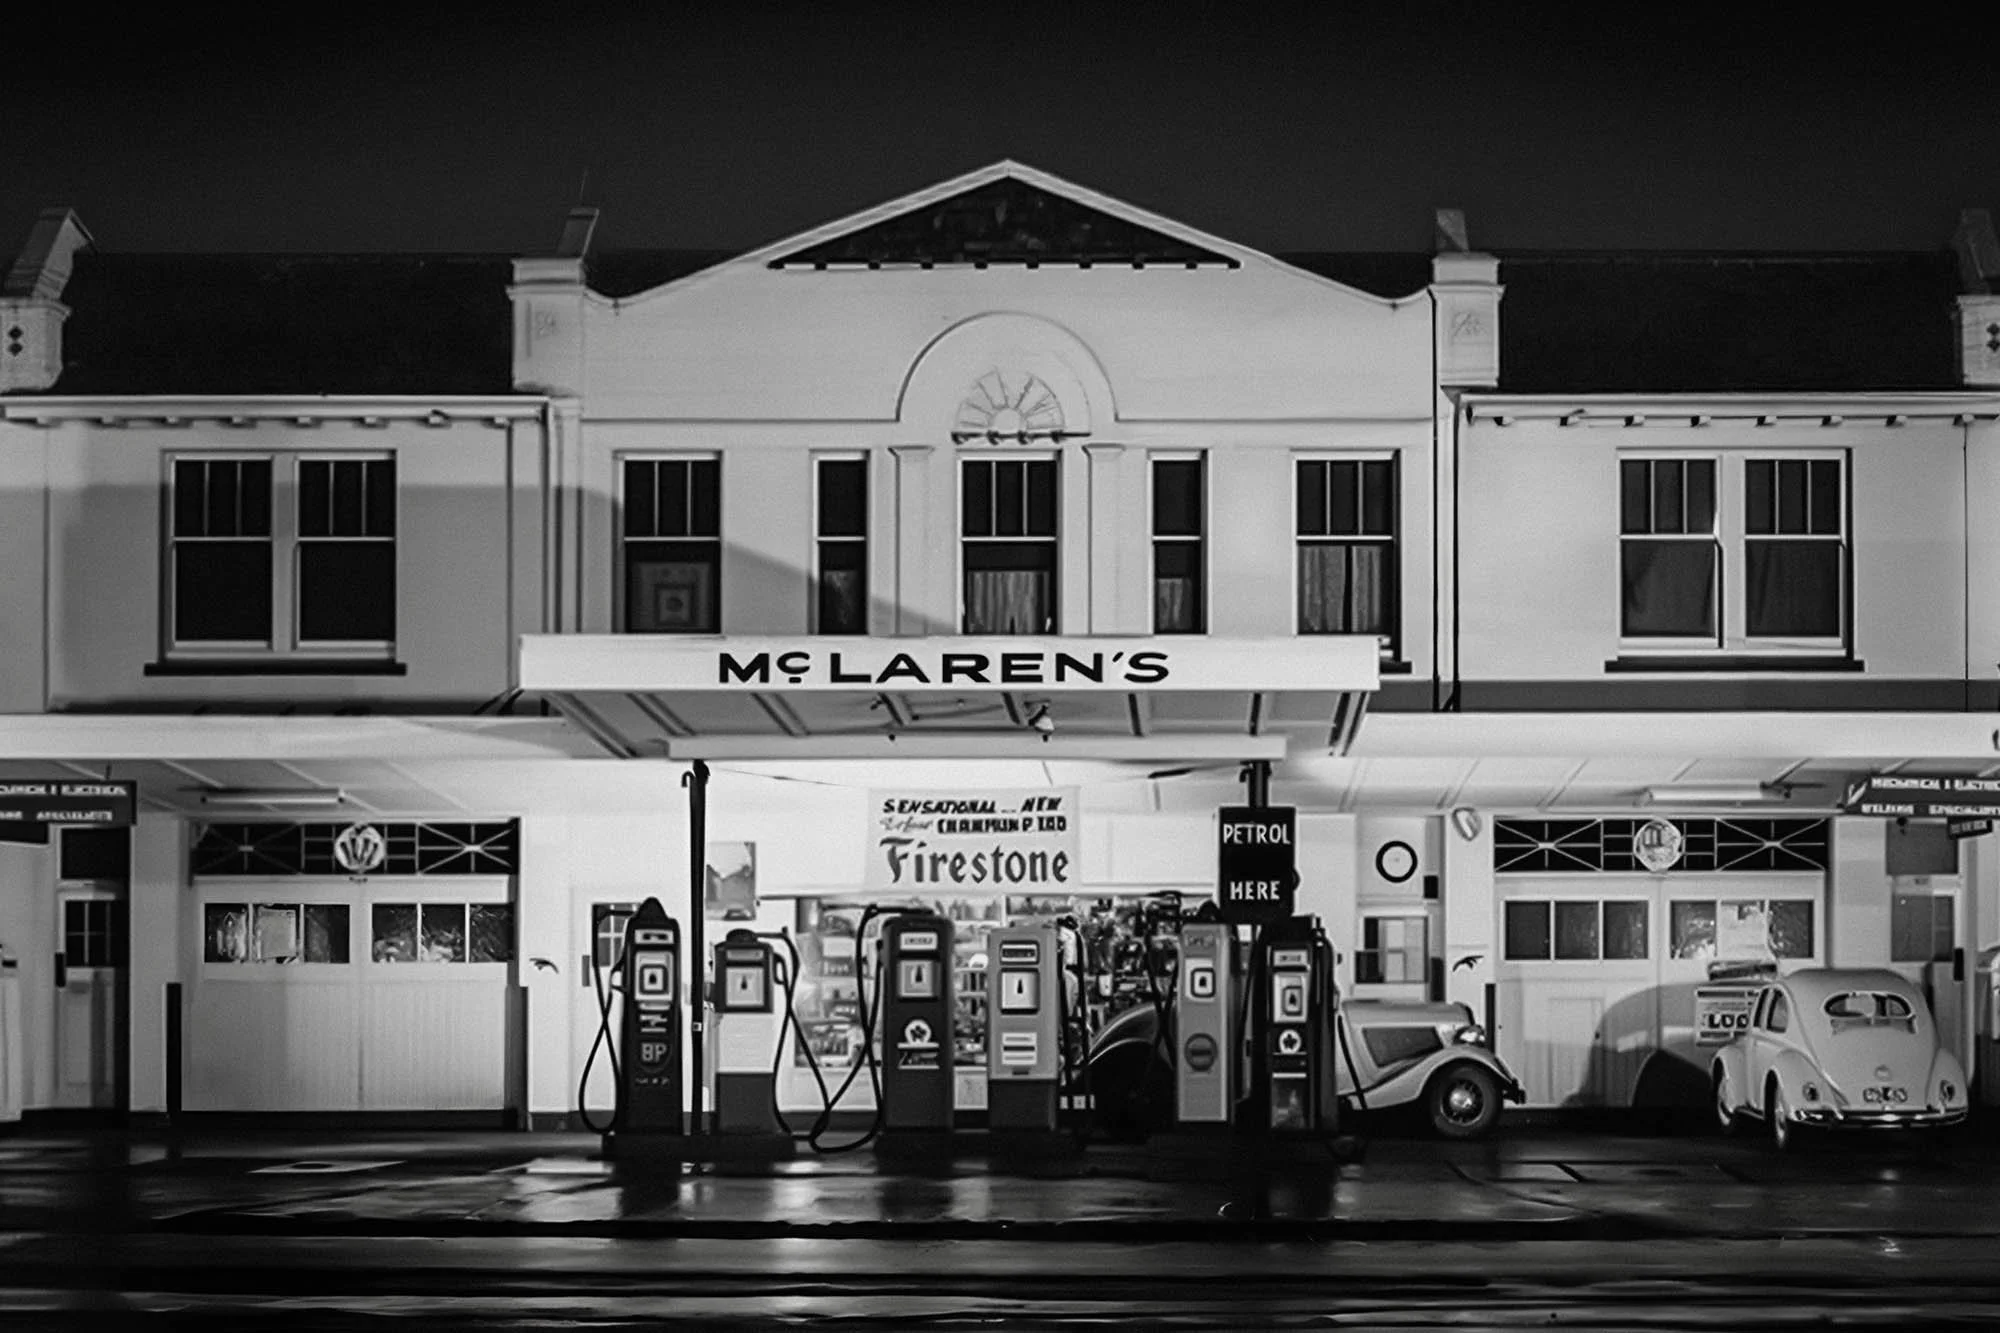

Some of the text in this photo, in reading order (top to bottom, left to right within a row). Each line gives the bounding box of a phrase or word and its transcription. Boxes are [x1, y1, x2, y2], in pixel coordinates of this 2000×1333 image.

[883, 797, 1062, 814] SENSATIONAL NEW
[1223, 823, 1291, 844] PETROL
[879, 837, 1069, 884] Firestone
[1230, 881, 1280, 900] HERE
[641, 1042, 667, 1063] BP
